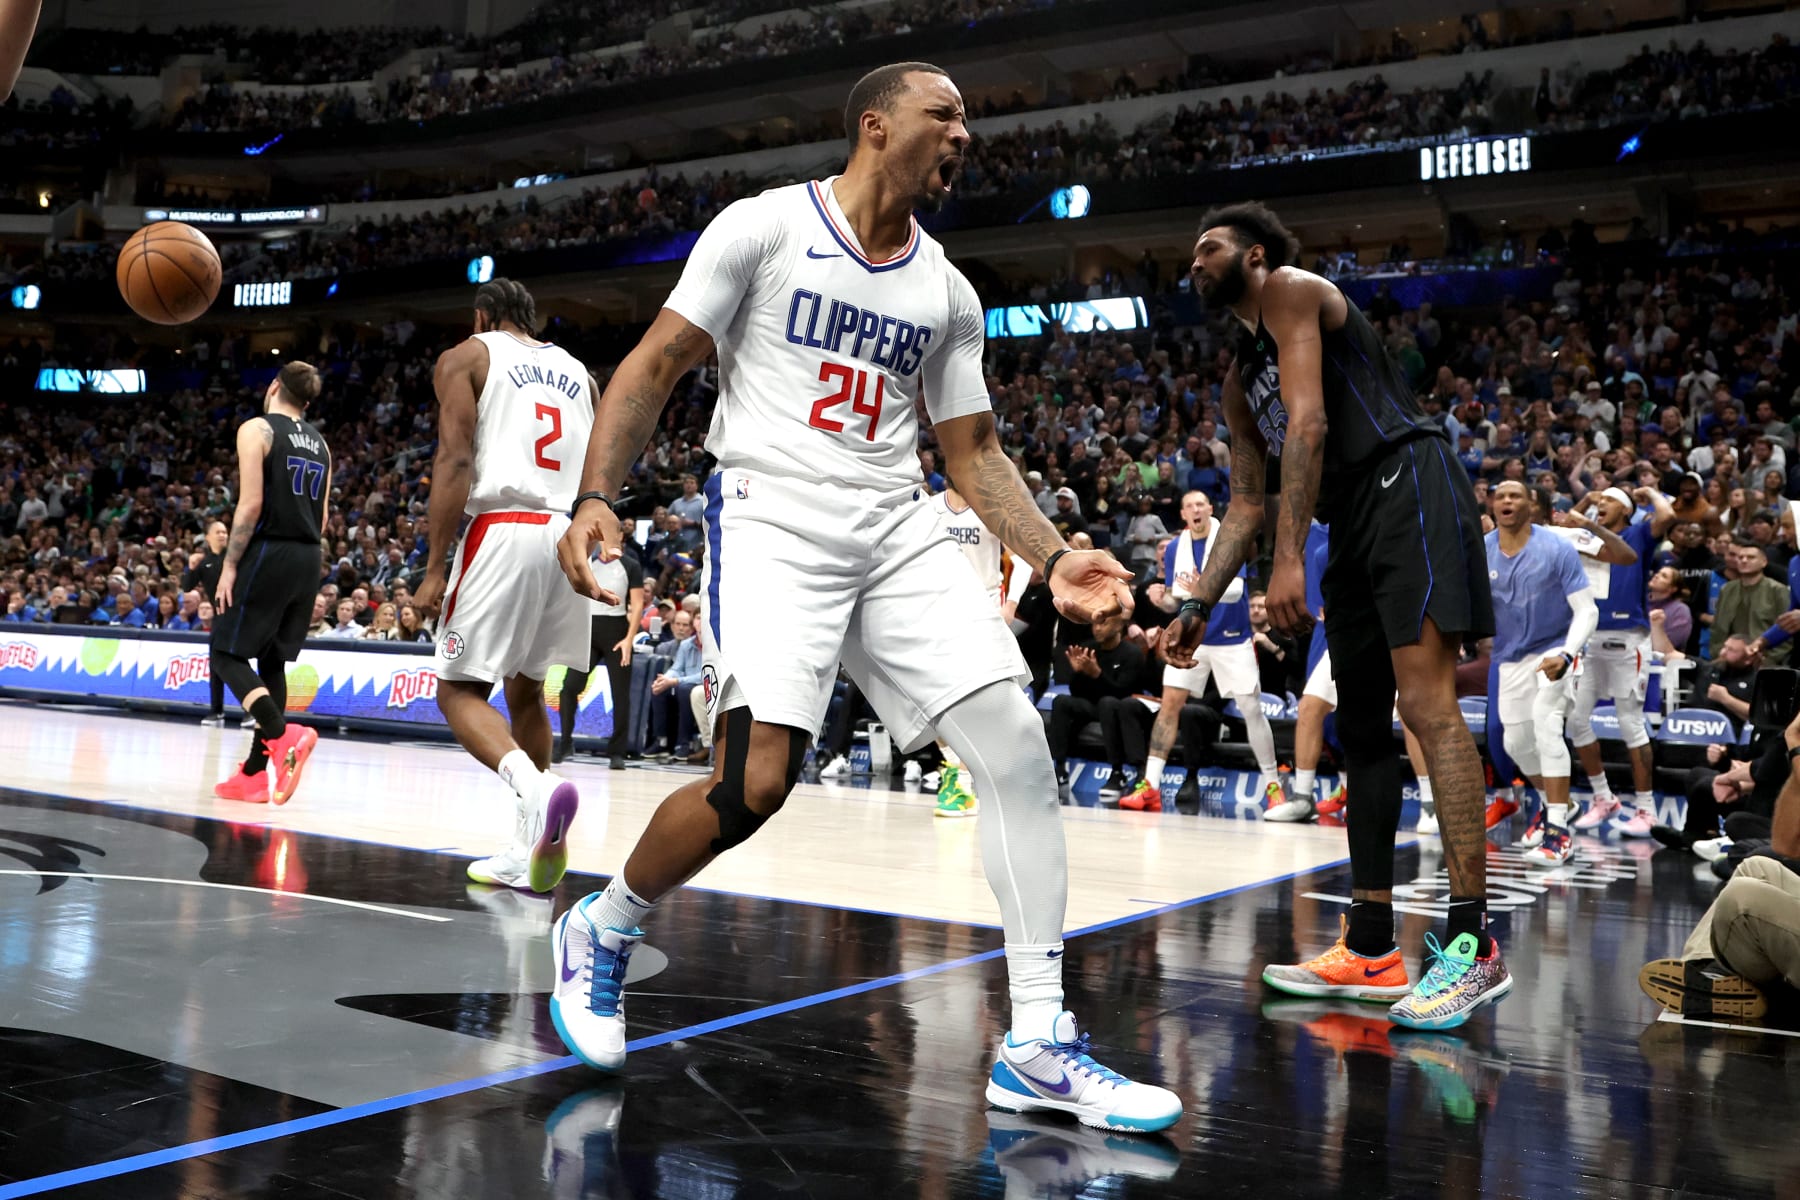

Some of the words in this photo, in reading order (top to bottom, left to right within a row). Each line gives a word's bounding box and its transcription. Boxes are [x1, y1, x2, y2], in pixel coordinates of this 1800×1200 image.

[1421, 137, 1530, 180] DEFENSE!
[234, 281, 292, 306] DEFENSE!
[785, 288, 931, 376] CLIPPERS
[507, 364, 581, 400] LEONARD
[809, 361, 885, 441] 24
[535, 402, 562, 471] 2
[287, 456, 325, 500] 77
[0, 645, 36, 668] UFFLES
[167, 658, 210, 687] RUFFL
[391, 672, 437, 704] RUFF
[1667, 719, 1726, 736] UTSW
